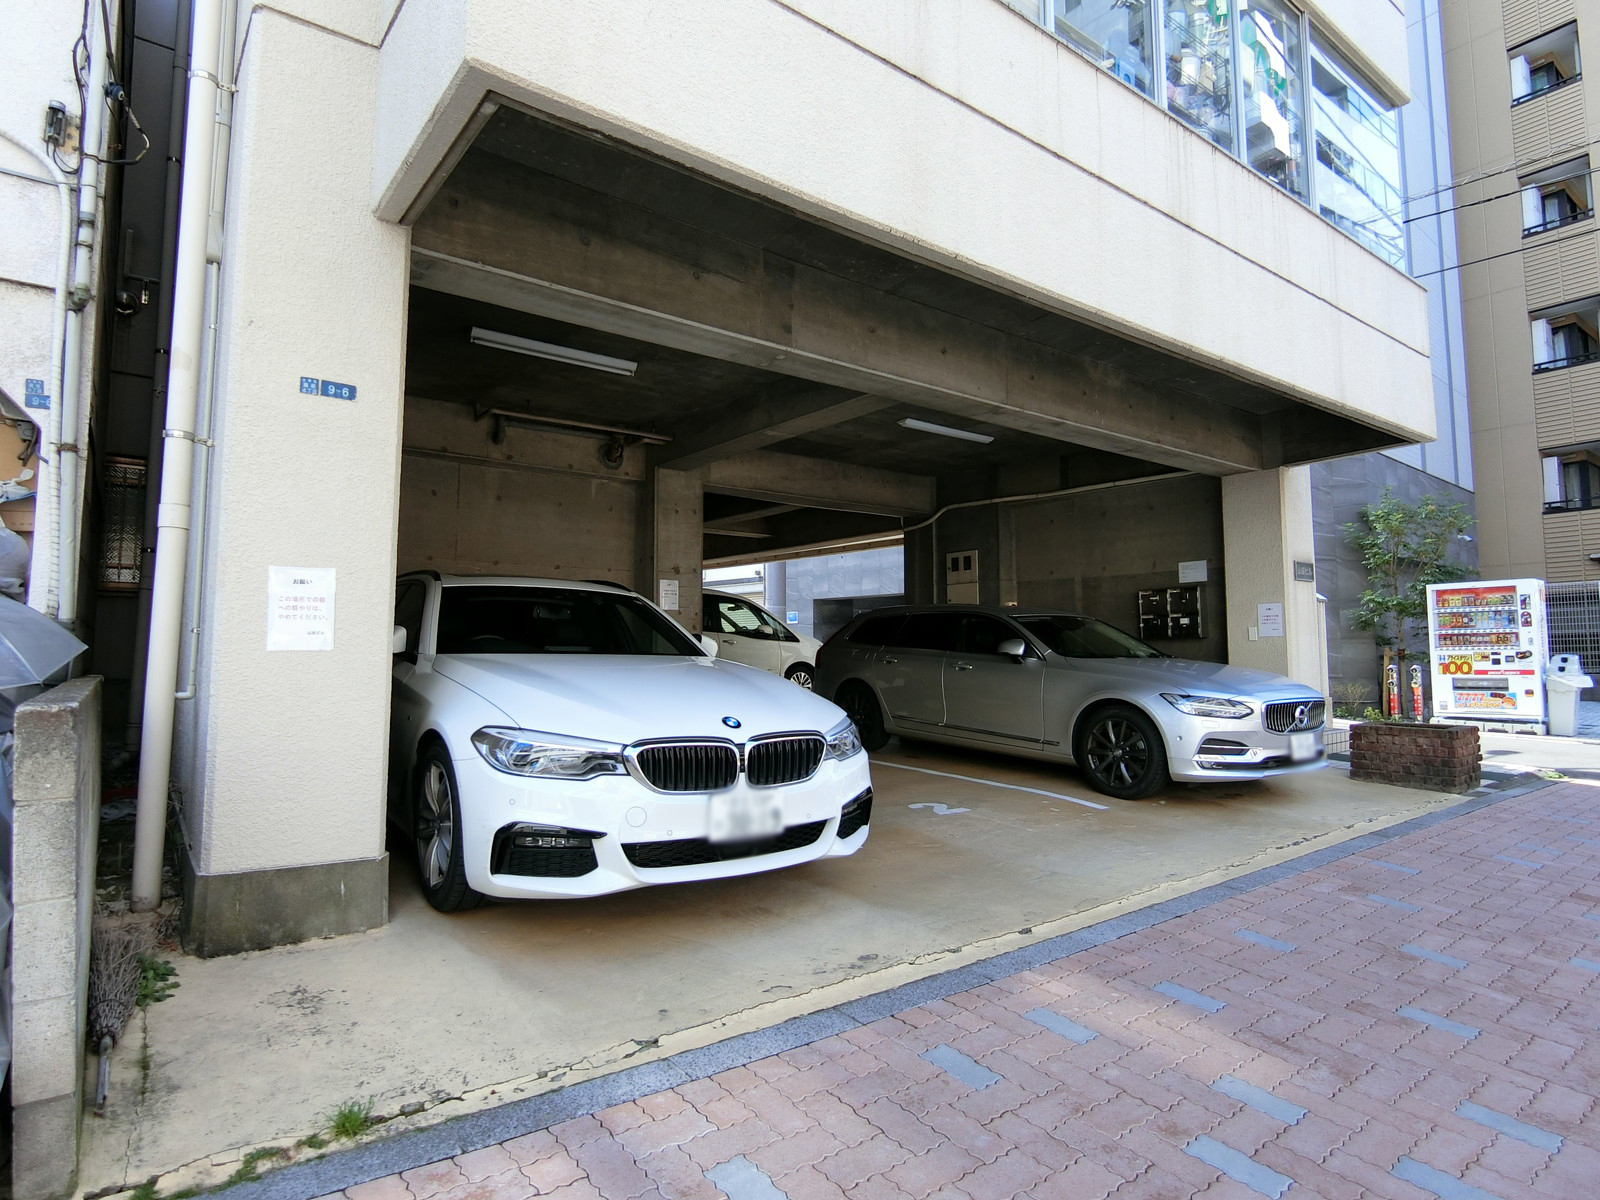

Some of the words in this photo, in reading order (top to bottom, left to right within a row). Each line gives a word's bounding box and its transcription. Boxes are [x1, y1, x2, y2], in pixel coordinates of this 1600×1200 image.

[328, 385, 349, 397] 9-6
[1438, 661, 1473, 675] 100
[908, 802, 971, 816] 2
